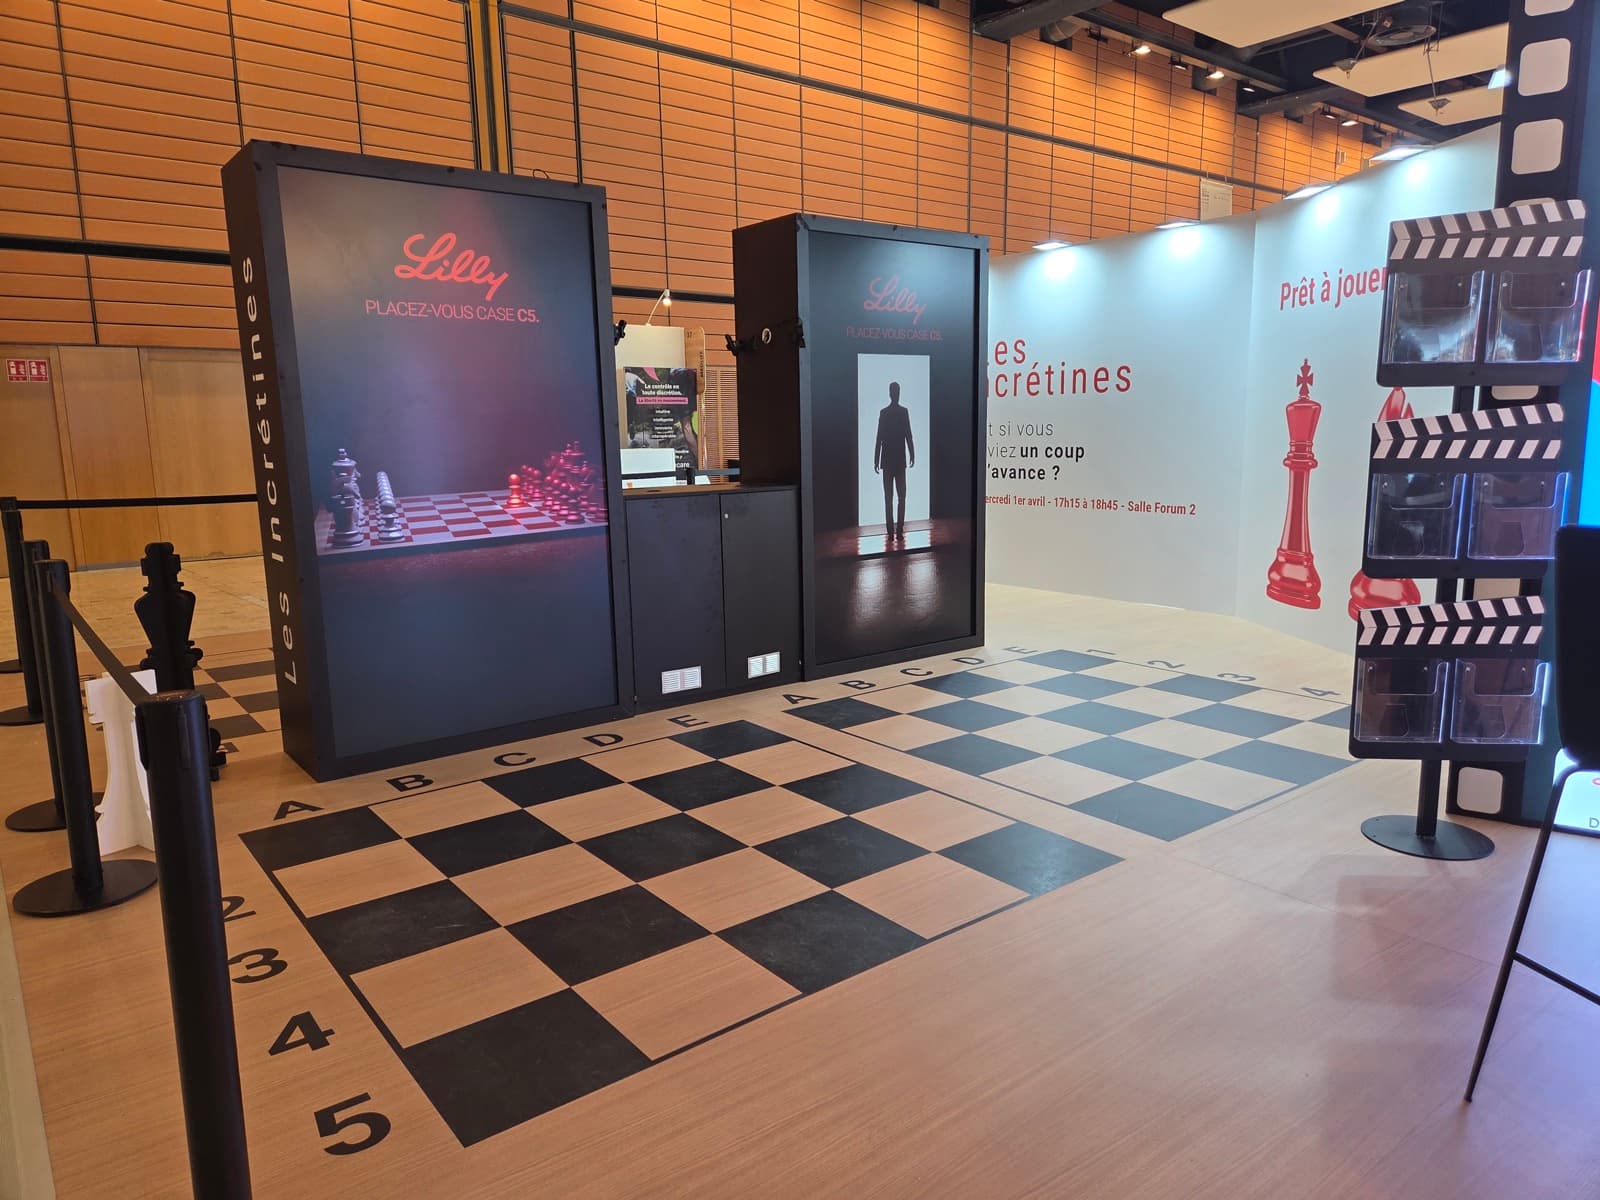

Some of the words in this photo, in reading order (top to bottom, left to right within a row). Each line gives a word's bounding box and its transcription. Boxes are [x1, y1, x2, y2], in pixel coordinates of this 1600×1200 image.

[394, 232, 509, 301] Lilly
[863, 274, 928, 325] Lilly
[1280, 276, 1315, 311] Prêt
[1320, 271, 1331, 303] à
[1334, 267, 1388, 309] jouer
[364, 299, 474, 320] PLACEZ-VOUS
[476, 306, 515, 322] CASE
[517, 308, 540, 323] C5.
[987, 339, 1026, 365] es
[986, 361, 1132, 398] crétines
[243, 256, 284, 563] Incrétines
[988, 422, 993, 437] t
[999, 421, 1011, 436] si
[1017, 423, 1054, 437] vous
[987, 442, 1016, 458] viez
[1020, 446, 1038, 458] un
[1045, 446, 1085, 463] coup
[987, 463, 1046, 480] 'avance
[1052, 465, 1060, 480] ?
[983, 494, 1011, 505] ercredi
[1013, 495, 1026, 506] 1er
[1028, 495, 1046, 507] avril
[1054, 497, 1081, 509] 17h15
[1082, 498, 1088, 509] à
[1090, 499, 1118, 511] 18h45
[1128, 501, 1152, 512] Salle
[1154, 502, 1186, 515] Forum
[1189, 504, 1197, 516] 2
[280, 591, 297, 685] Les
[782, 693, 819, 704] A
[839, 679, 877, 690] B
[900, 667, 933, 677] C
[952, 656, 985, 665] D
[1147, 659, 1186, 669] 2
[1217, 672, 1257, 682] 3
[1299, 686, 1341, 697] 4
[273, 800, 324, 820] A
[386, 773, 434, 792] B
[494, 751, 537, 767] C
[583, 732, 624, 747] D
[669, 714, 710, 728] E
[221, 895, 257, 922] 2
[227, 947, 288, 984] 3
[268, 1010, 336, 1057] 4
[313, 1091, 392, 1156] 5
